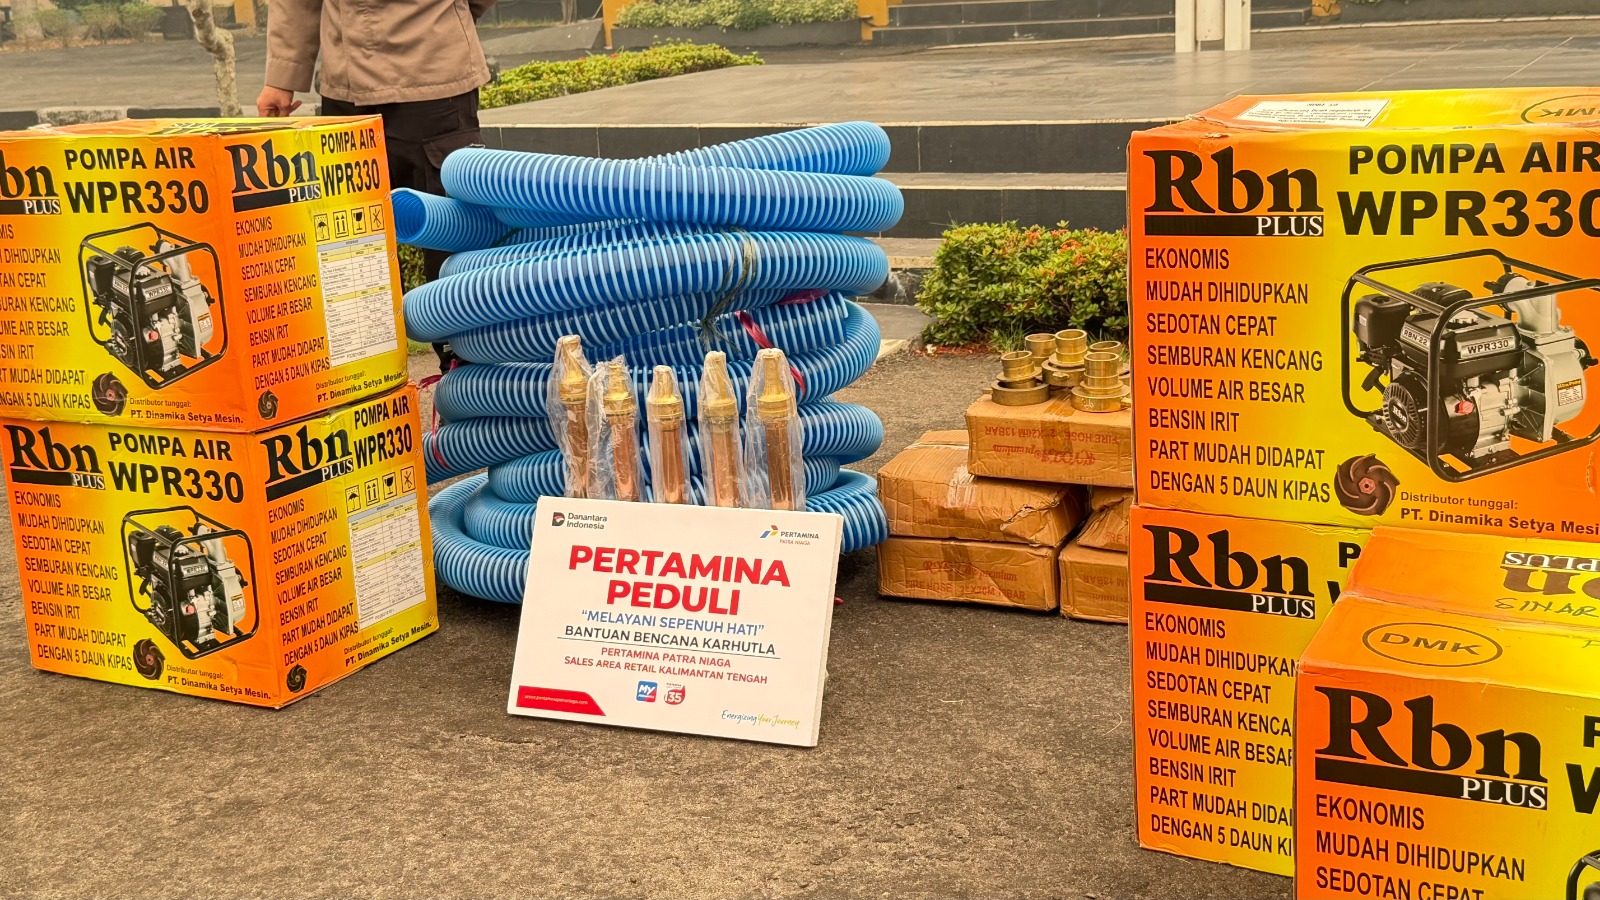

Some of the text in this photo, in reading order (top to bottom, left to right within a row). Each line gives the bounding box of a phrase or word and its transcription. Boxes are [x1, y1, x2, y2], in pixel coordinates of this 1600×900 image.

[1536, 107, 1600, 117] MK
[321, 128, 376, 154] POMPA AIR
[64, 147, 196, 170] POMPA AIR
[225, 138, 319, 193] Rbn
[1349, 141, 1600, 174] POMPA AIR
[0, 151, 59, 198] bn
[321, 158, 380, 197] WPR330
[1143, 146, 1324, 214] Rbn
[63, 180, 209, 214] WPR330
[289, 185, 321, 202] PLUS
[24, 200, 61, 214] PLUS
[1337, 189, 1600, 237] WPR330
[236, 216, 272, 236] EKONOMIS
[1256, 216, 1323, 236] PLUS
[1145, 248, 1230, 269] EKONOMIS
[1146, 281, 1308, 304] MUDAH DIHIDUPKAN
[1147, 313, 1277, 336] SEDOTAN CEPAT
[1148, 345, 1322, 371] SEMBURAN KENCANG
[1467, 339, 1509, 355] WPR330
[1148, 377, 1305, 403] VOLUME AIR BESAR
[354, 395, 410, 430] POMPA AIR
[1150, 408, 1239, 432] BENSIN IRIT
[985, 426, 1015, 436] 13BAR
[1065, 431, 1092, 441] HOSE
[4, 425, 103, 474] Rbn
[108, 432, 233, 461] POMPA AIR
[260, 425, 352, 484] Rbn
[354, 423, 412, 470] WPR330
[1150, 439, 1324, 469] PART MUDAH DIDAPAT
[72, 473, 105, 490] PLUS
[107, 461, 244, 503] WPR330
[321, 458, 353, 482] PLUS
[15, 491, 61, 508] EKONOMIS
[1151, 470, 1330, 503] DENGAN 5 DAUN KIPAS
[268, 499, 305, 524] EKONOMIS
[1401, 492, 1518, 510] Distributor tunggal:
[18, 512, 105, 535] MUDAH DIHIDUPKAN
[567, 520, 604, 529] Indonesia
[568, 513, 607, 522] Danantara
[1401, 508, 1600, 535] PT. Dinamika Setya Mesi
[22, 535, 90, 555] SEDOTAN CEPAT
[781, 531, 819, 539] PERTAMINA
[25, 557, 118, 581] SEMBURAN KENCANG
[568, 545, 790, 587] PERTAMINA
[1143, 524, 1314, 597] Rbn
[1505, 552, 1600, 572] PLUS
[28, 579, 112, 602] VOLUME AIR BESAR
[607, 580, 741, 615] PEDULI
[31, 601, 80, 620] BENSIN IRIT
[280, 598, 319, 627] BENSIN IRIT
[1251, 594, 1314, 618] PLUS
[34, 622, 126, 648] PART MUDAH DIDAPAT
[660, 617, 723, 633] SEPENUH
[1146, 612, 1225, 638] EKONOMIS
[565, 626, 775, 655] BANTUAN BENCANA KARHUTLA
[1147, 641, 1200, 665] MUDAH
[1380, 632, 1483, 656] DMK
[38, 644, 132, 671] DENGAN 5 DAUN KIPAS
[166, 664, 198, 675] Distributor
[564, 656, 768, 684] SALES AREA RETAIL KALIMANTAN TENGAH
[601, 647, 731, 668] PERTAMINA PATRA NIAGA
[167, 676, 272, 700] PT. Dinamika Setya Mesin.
[1147, 670, 1271, 704] SEDOTAN CEPAT
[1148, 700, 1292, 737] SEMBURAN KENCA
[1148, 728, 1210, 754] VOLUME
[1215, 738, 1240, 759] AIR
[1315, 686, 1548, 783] Rbn
[1150, 757, 1236, 787] BENSIN IRIT
[1461, 777, 1546, 809] PLUS
[1150, 786, 1292, 827] PART MUDAH DIDA
[1316, 794, 1424, 830] EKONOMIS
[1151, 814, 1212, 842] DENGAN
[1217, 827, 1225, 844] 5
[1230, 828, 1271, 852] DAUN
[1316, 830, 1389, 862] MUDAH
[1396, 841, 1525, 881] DIHIDUPKAN
[1317, 866, 1410, 900] SEDOTAN
